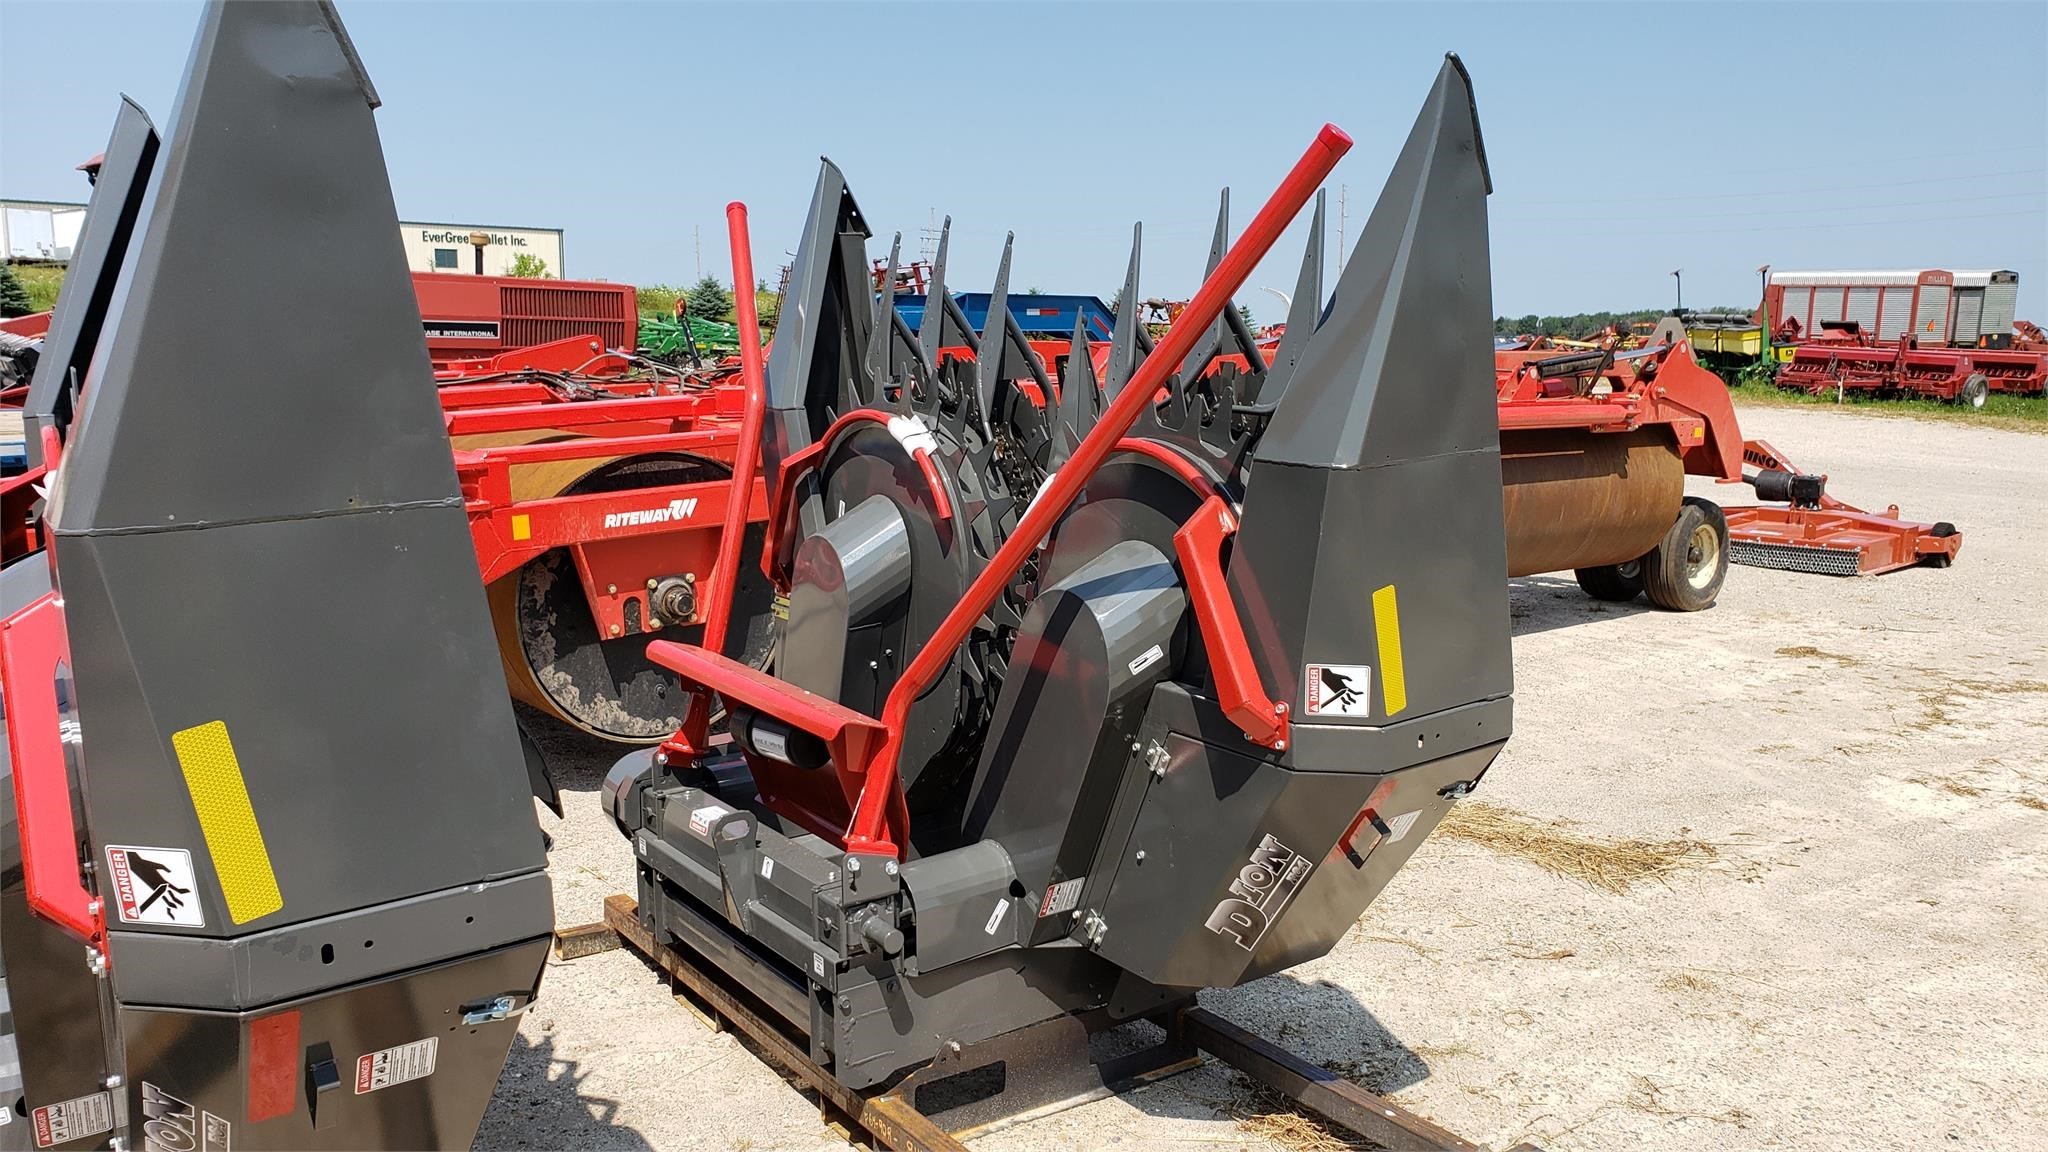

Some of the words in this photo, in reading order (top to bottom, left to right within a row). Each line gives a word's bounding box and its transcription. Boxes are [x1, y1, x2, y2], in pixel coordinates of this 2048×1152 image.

[422, 230, 470, 243] EverGree
[511, 235, 528, 247] Inc.
[424, 329, 441, 337] ASE
[443, 329, 495, 338] INTERNATIONAL
[604, 507, 674, 529] RITEWAY
[1309, 668, 1319, 702] DANGER
[112, 852, 135, 902] DANGER
[1204, 833, 1294, 951] DION
[361, 1060, 371, 1083] DANGER
[37, 1111, 49, 1137] DANGER
[142, 1081, 195, 1152] ON
